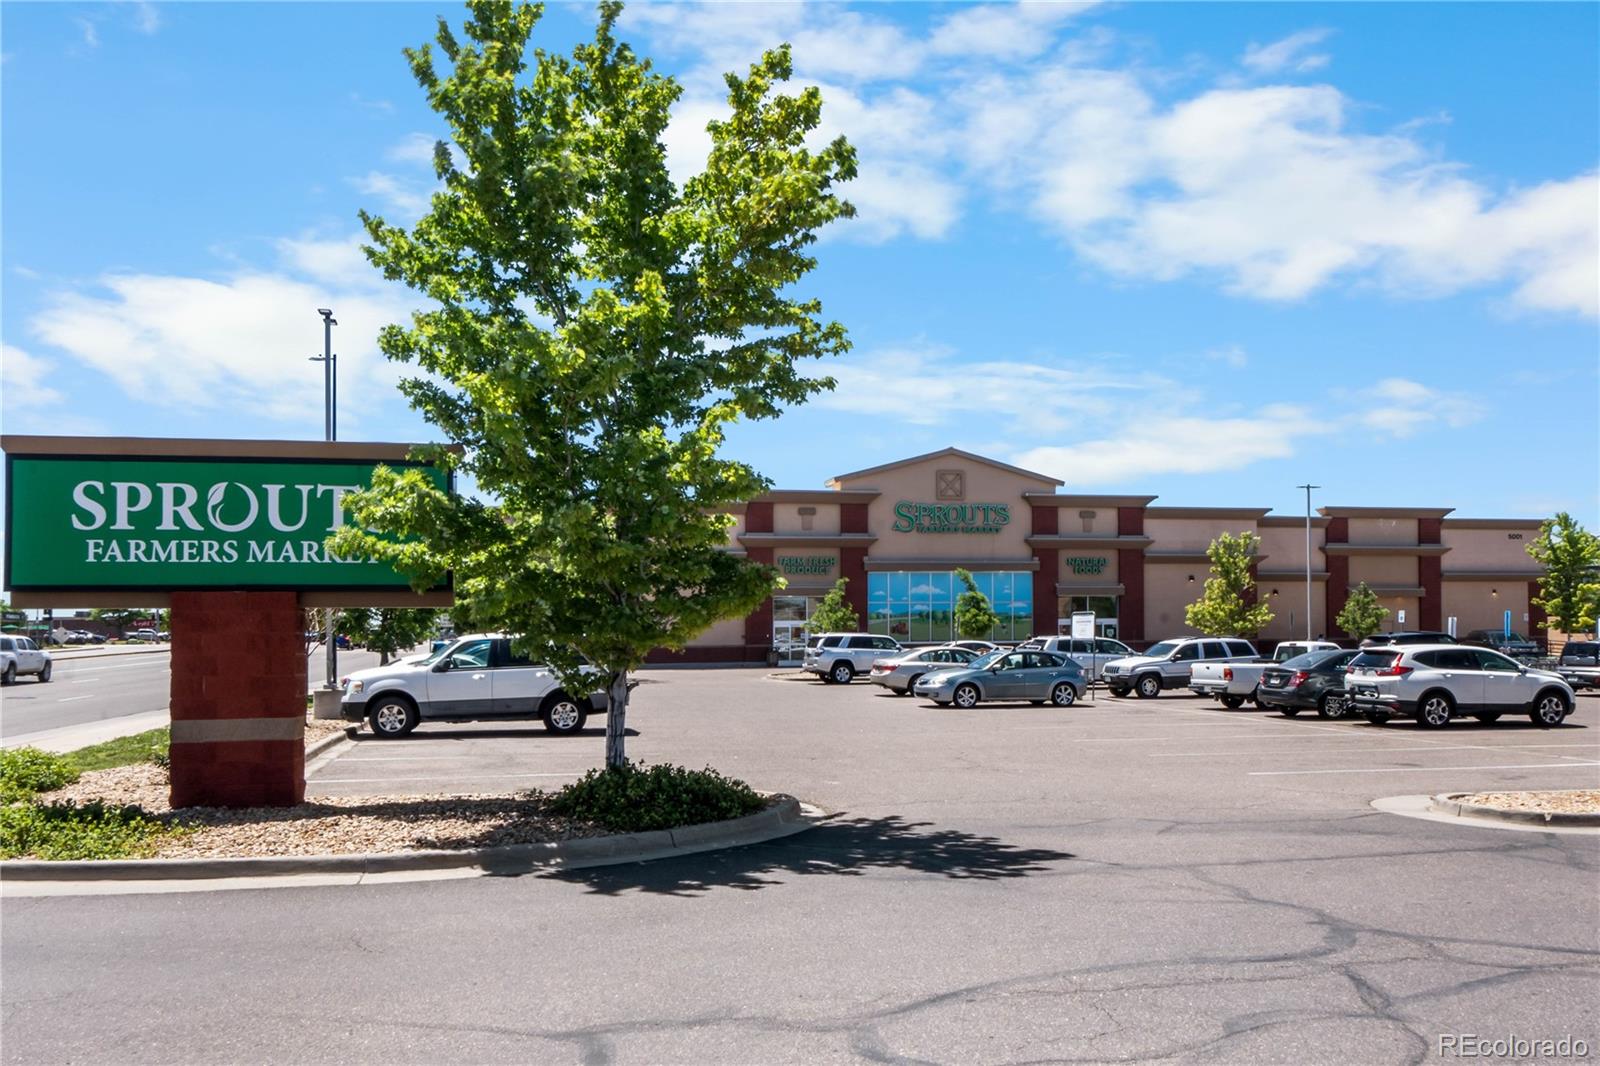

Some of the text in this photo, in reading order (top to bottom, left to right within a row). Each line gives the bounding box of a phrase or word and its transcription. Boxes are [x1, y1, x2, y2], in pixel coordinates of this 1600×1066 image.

[71, 480, 386, 533] SPROUT
[892, 500, 1010, 532] SPROUTS
[85, 539, 239, 563] FARMERS
